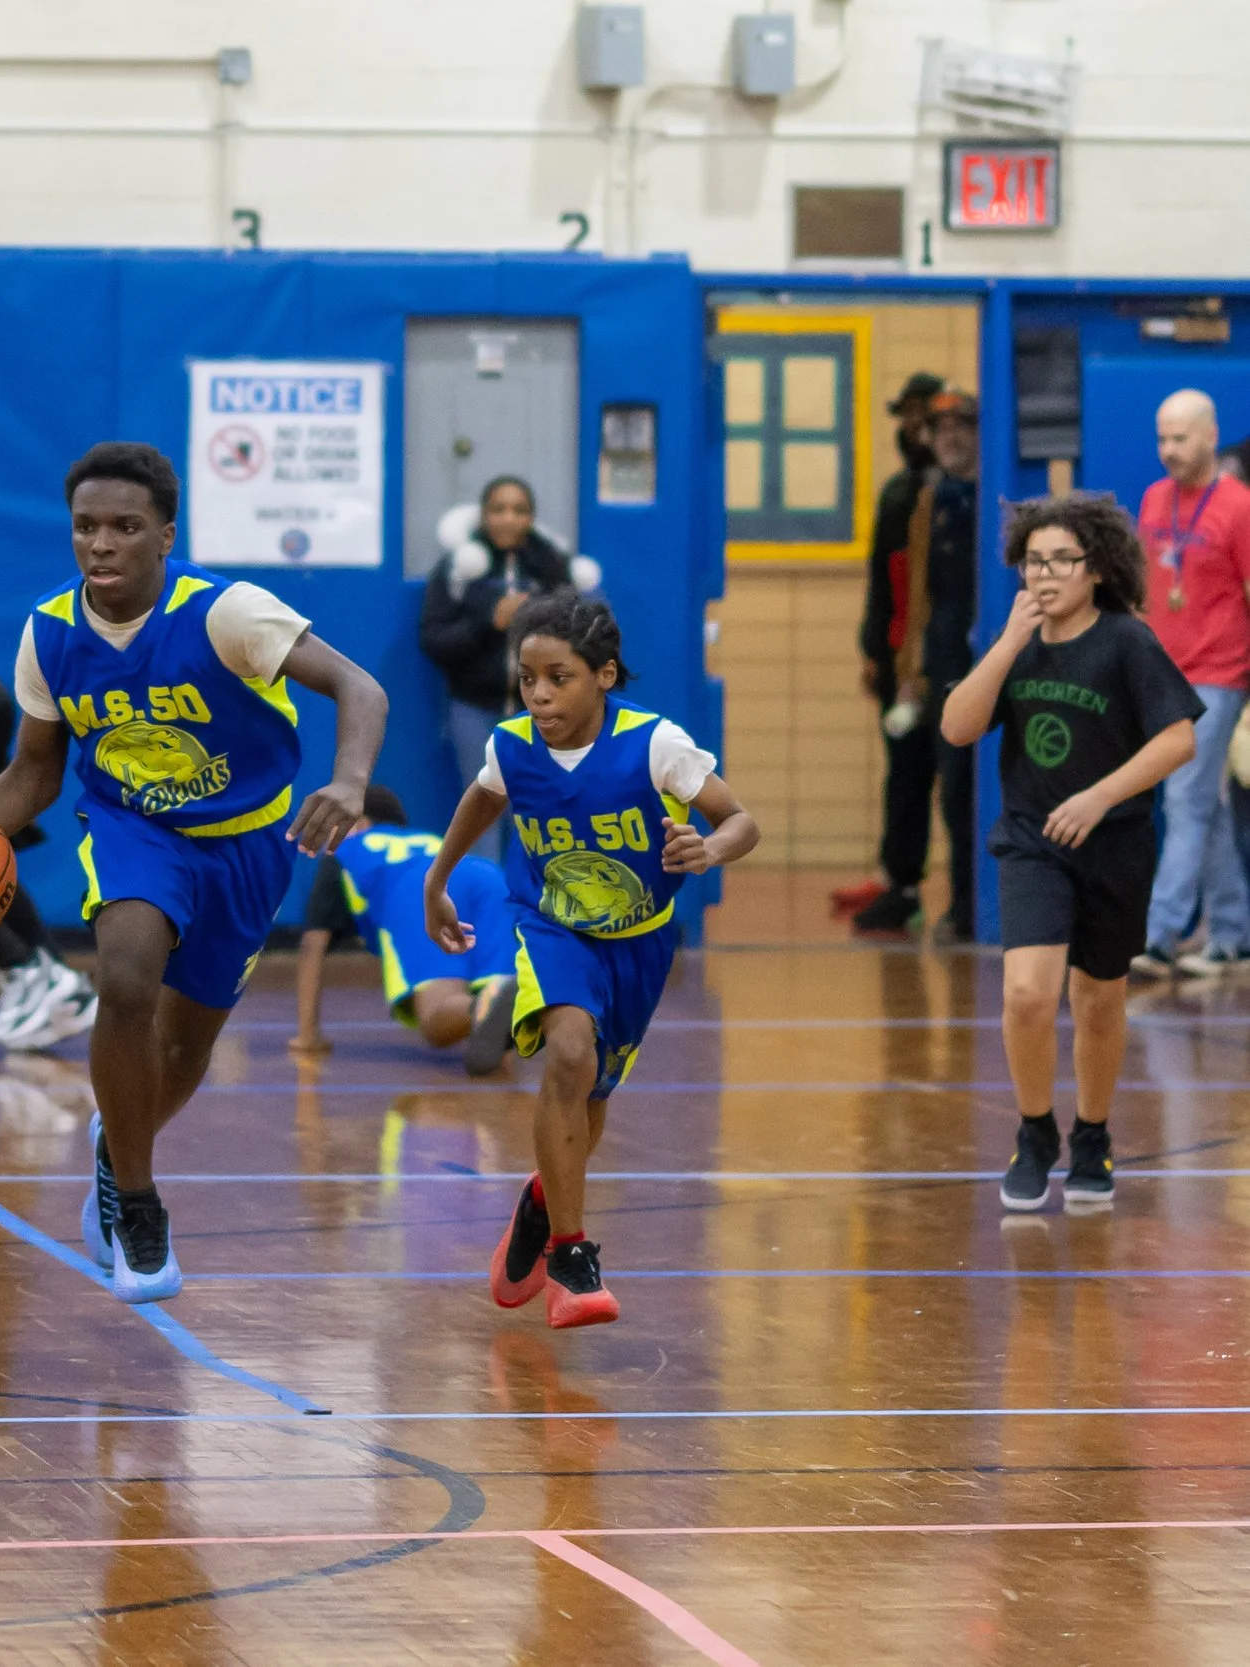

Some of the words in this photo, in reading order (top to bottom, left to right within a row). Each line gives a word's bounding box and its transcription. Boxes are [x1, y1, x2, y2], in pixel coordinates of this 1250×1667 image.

[961, 155, 1052, 224] EXIT
[558, 212, 590, 252] 2
[921, 219, 932, 266] 1
[215, 379, 358, 413] NOTICE
[59, 690, 146, 738] M.S.
[148, 683, 212, 724] 50
[1010, 679, 1110, 715] ERGREEN
[513, 814, 587, 858] M.S.
[590, 806, 650, 852] 50
